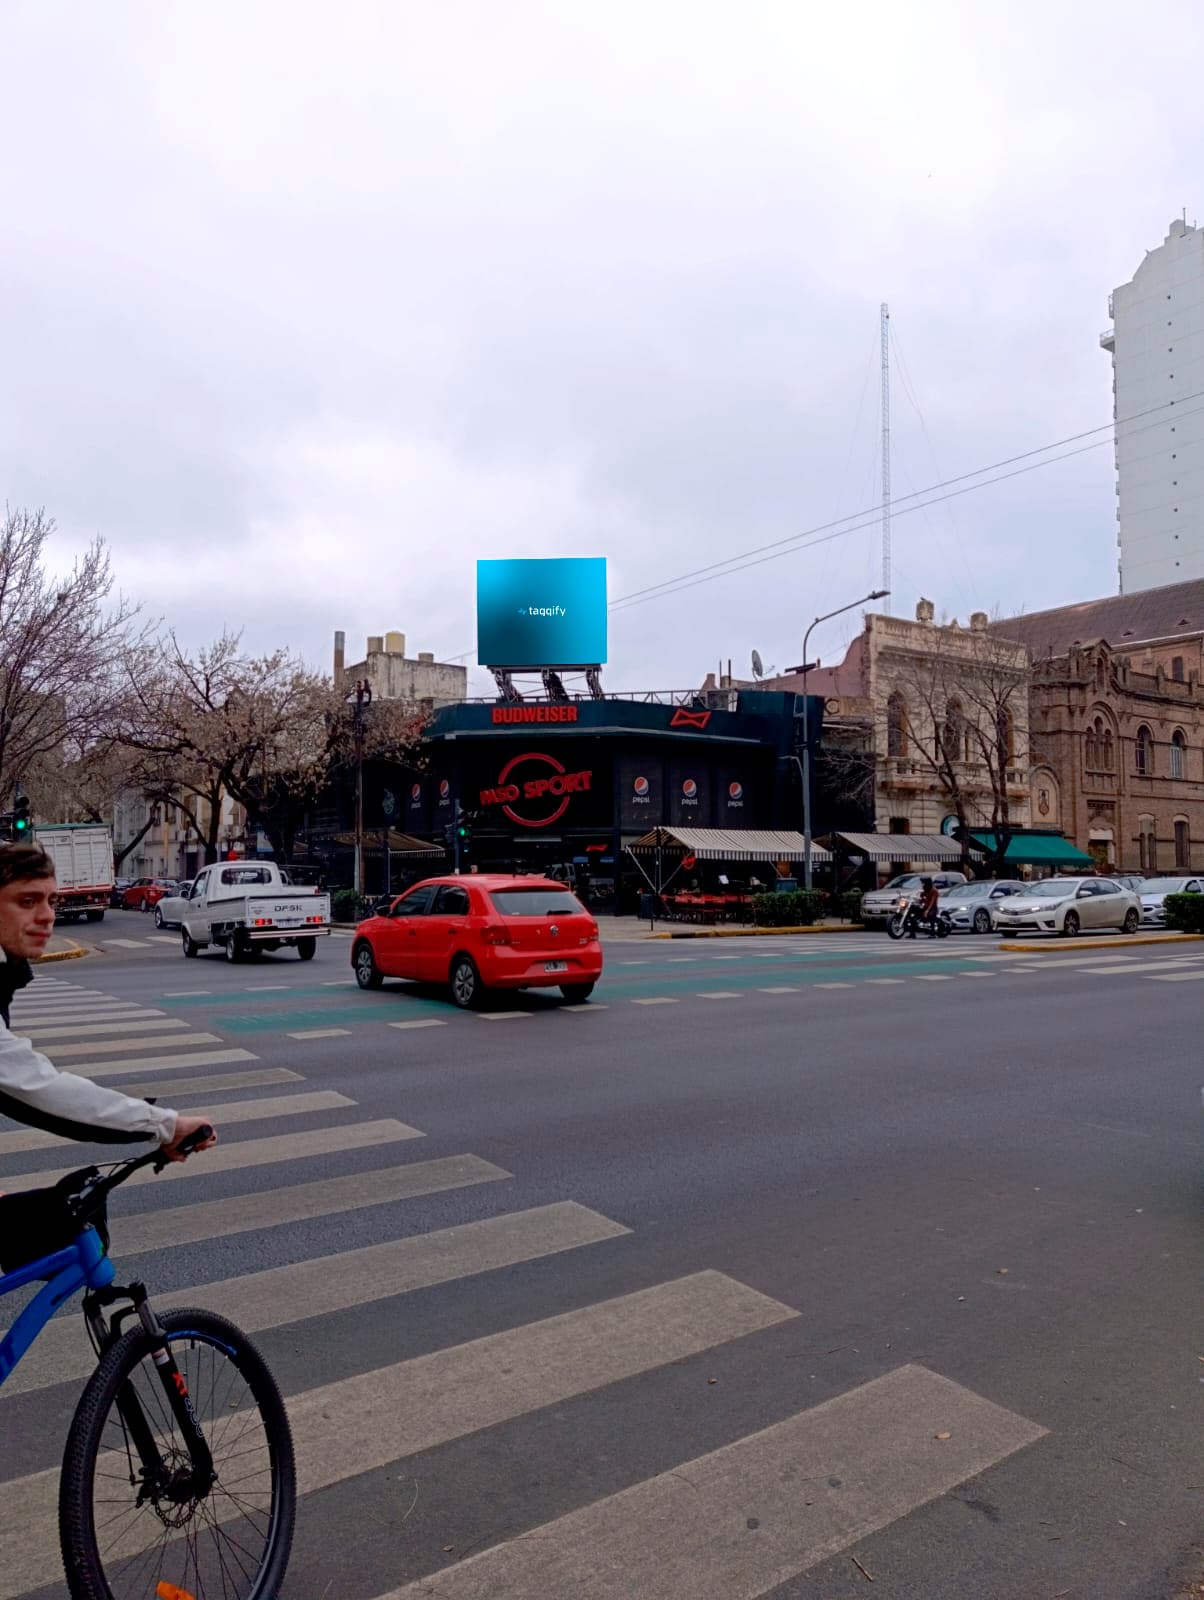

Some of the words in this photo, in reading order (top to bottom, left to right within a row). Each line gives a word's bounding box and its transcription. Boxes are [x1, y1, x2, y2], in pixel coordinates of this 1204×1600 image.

[491, 705, 578, 724] BUDWEISER
[523, 770, 593, 799] SPORT
[273, 903, 303, 912] DFSK
